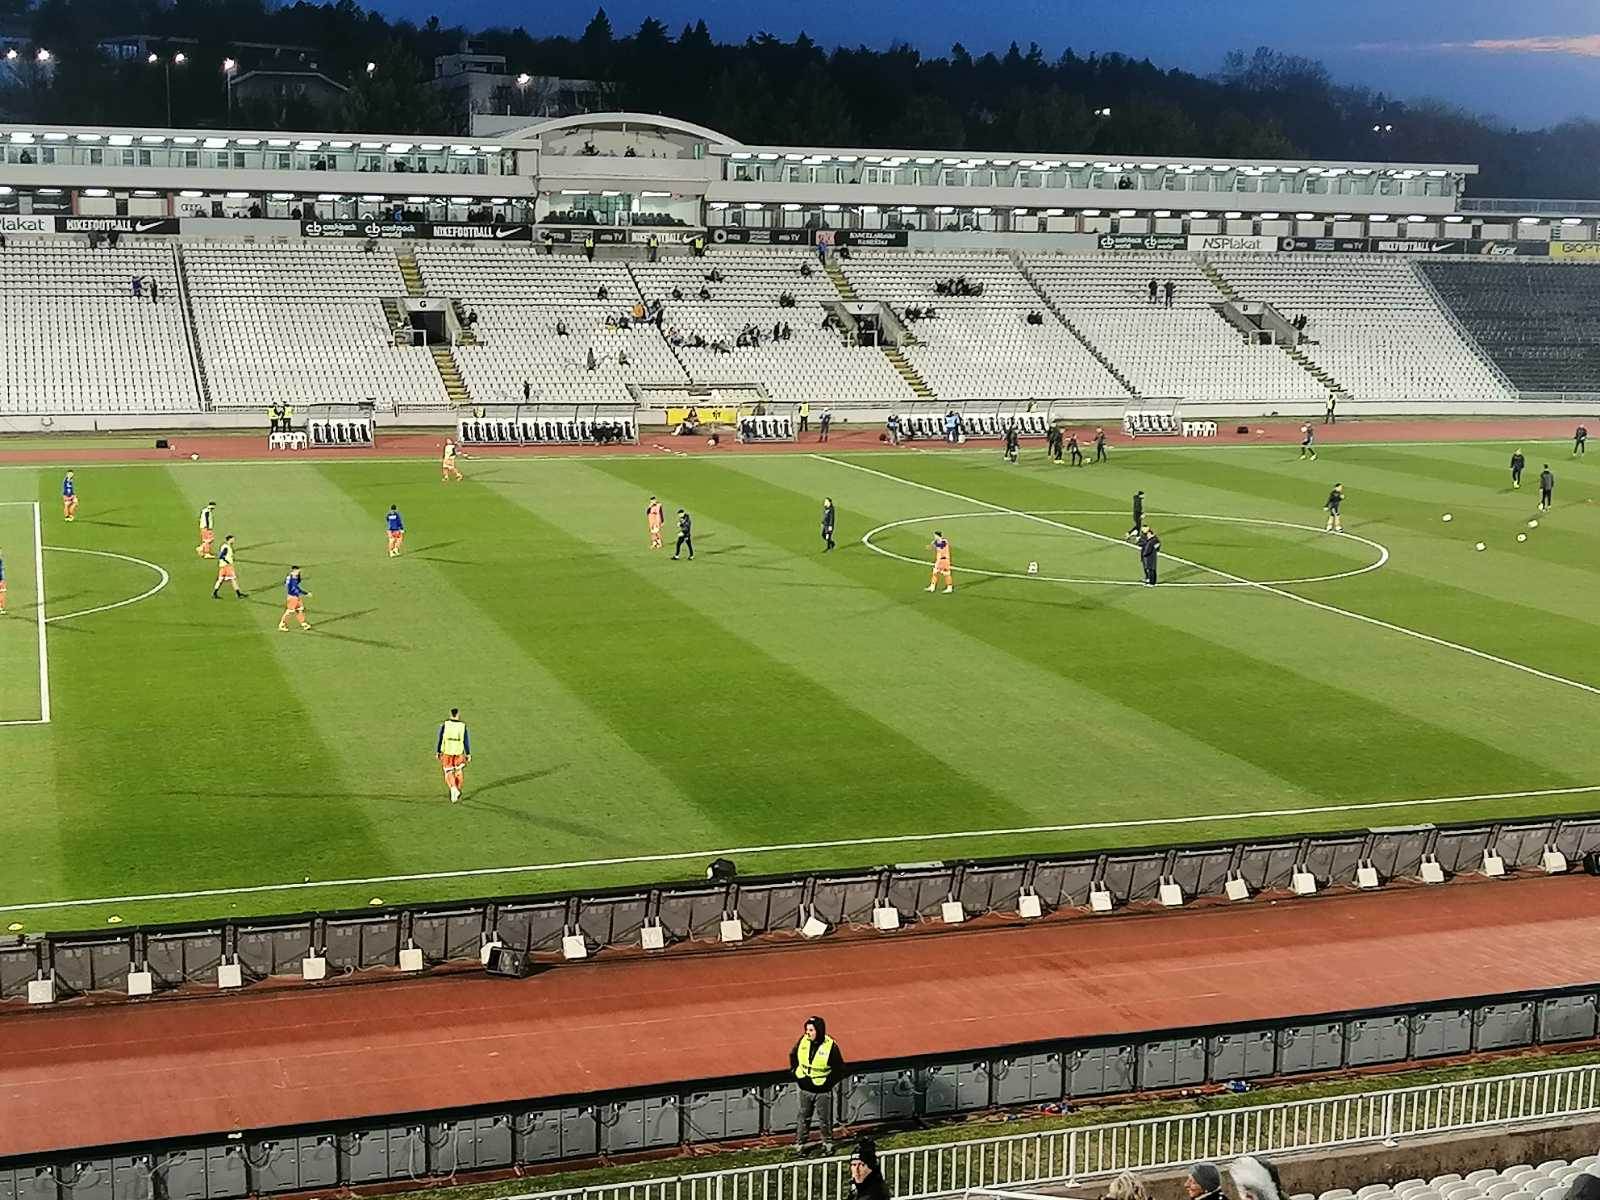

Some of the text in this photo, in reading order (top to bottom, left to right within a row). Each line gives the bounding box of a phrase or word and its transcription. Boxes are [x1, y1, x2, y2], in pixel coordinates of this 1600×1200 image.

[0, 216, 46, 231] lakat
[66, 219, 133, 232] NIKEFOOTBALL
[433, 226, 494, 238] NIKEFOOTBALL
[1202, 237, 1263, 250] NSPlakat
[419, 300, 427, 308] G
[857, 303, 864, 311] V
